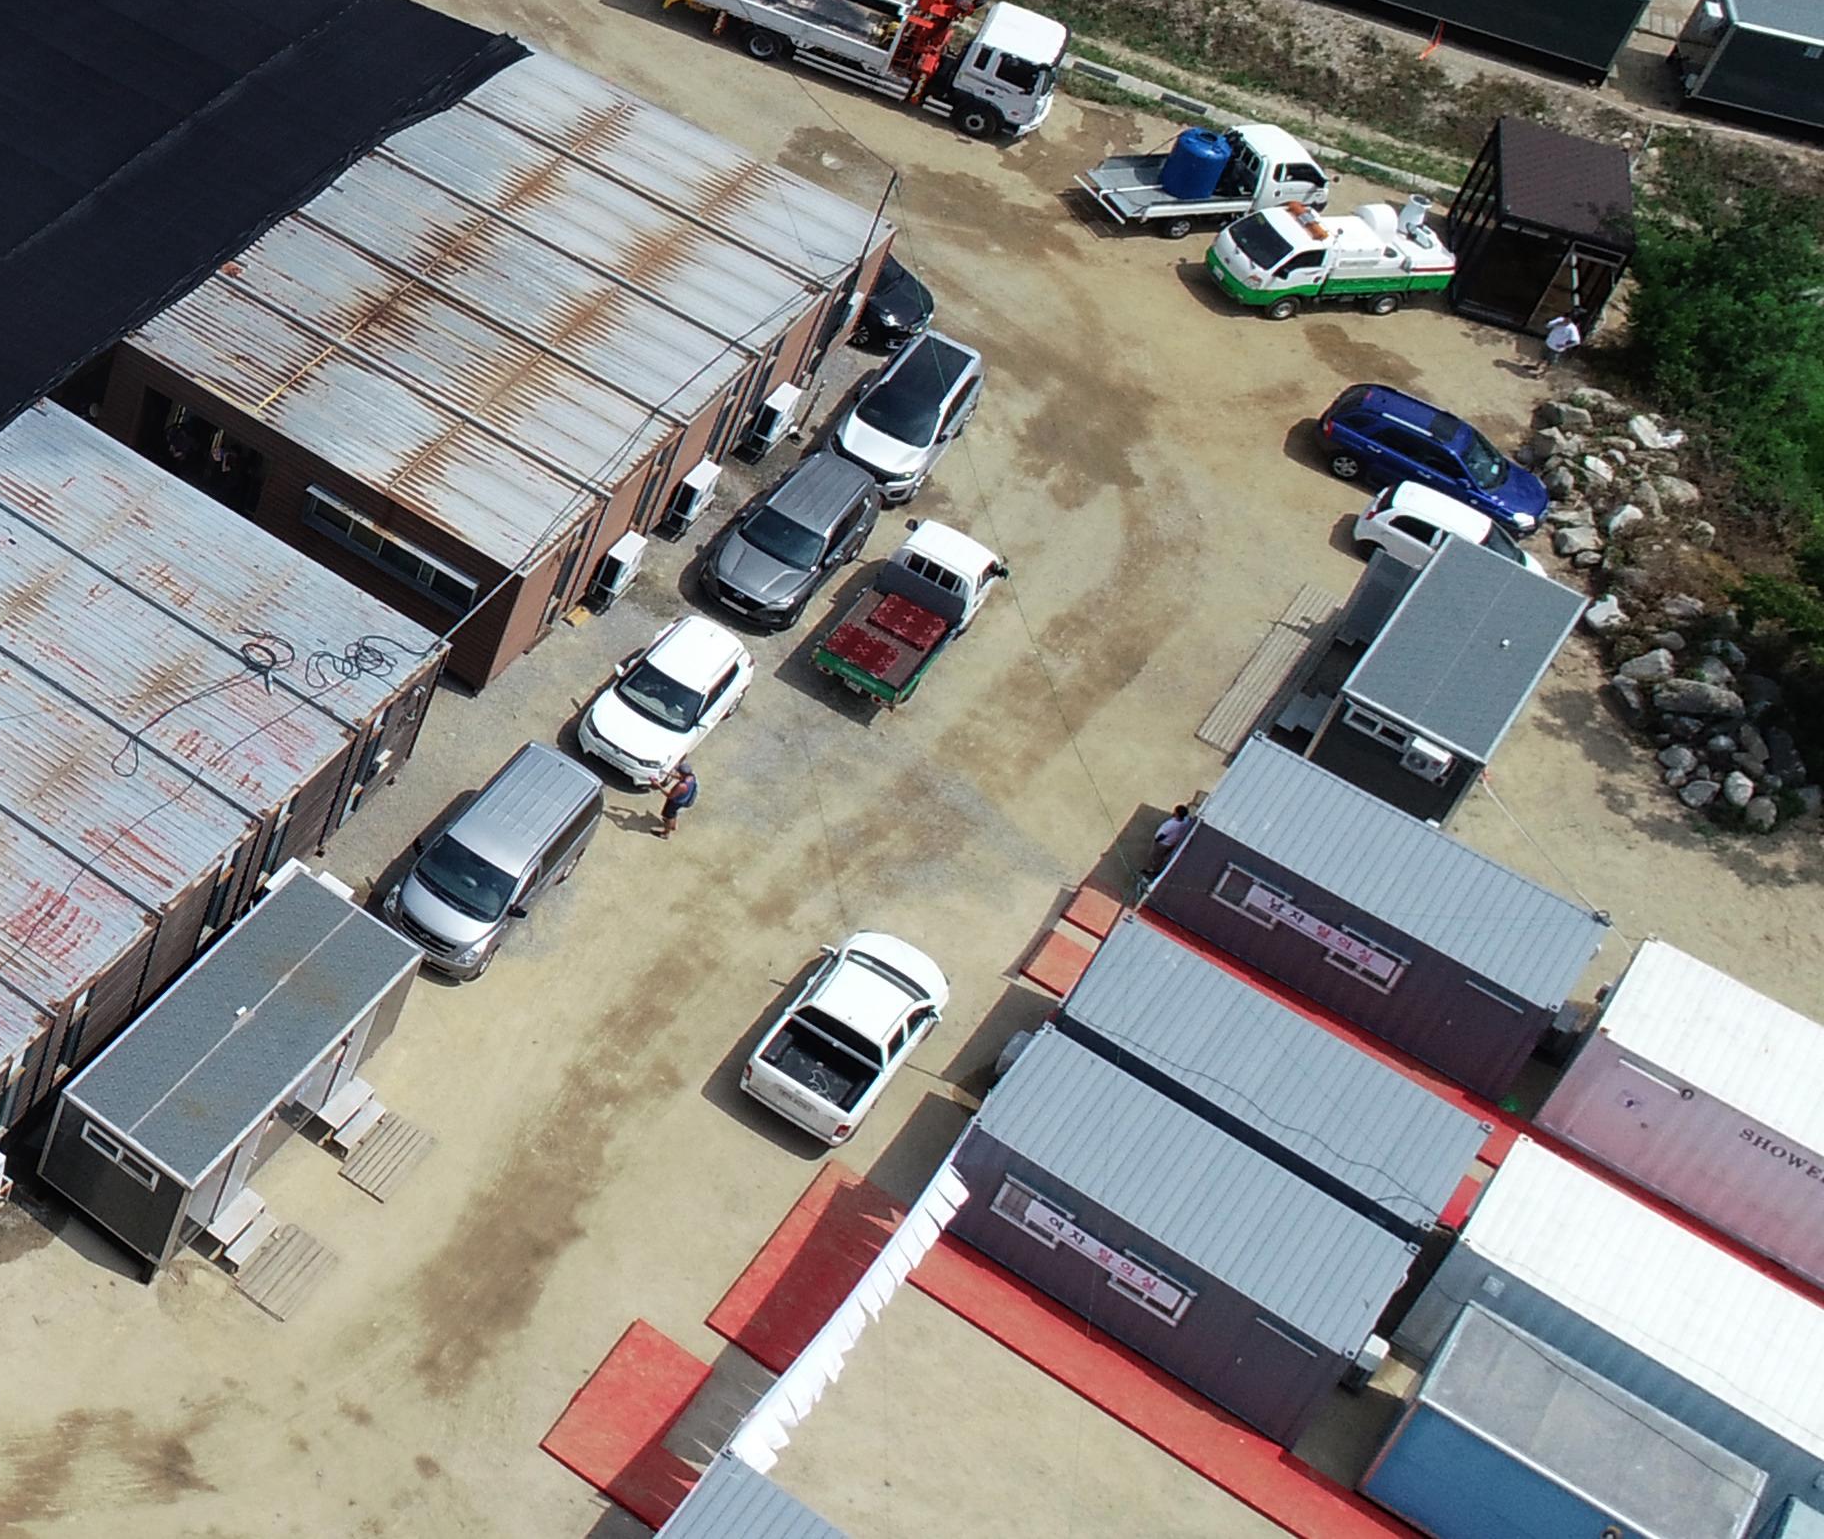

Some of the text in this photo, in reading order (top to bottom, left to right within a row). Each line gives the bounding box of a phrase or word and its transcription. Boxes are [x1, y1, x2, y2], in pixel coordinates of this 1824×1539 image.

[1315, 924, 1374, 964] 탈의실
[1739, 1127, 1824, 1181] SHOWE
[1048, 1217, 1158, 1291] 여자 탈의실
